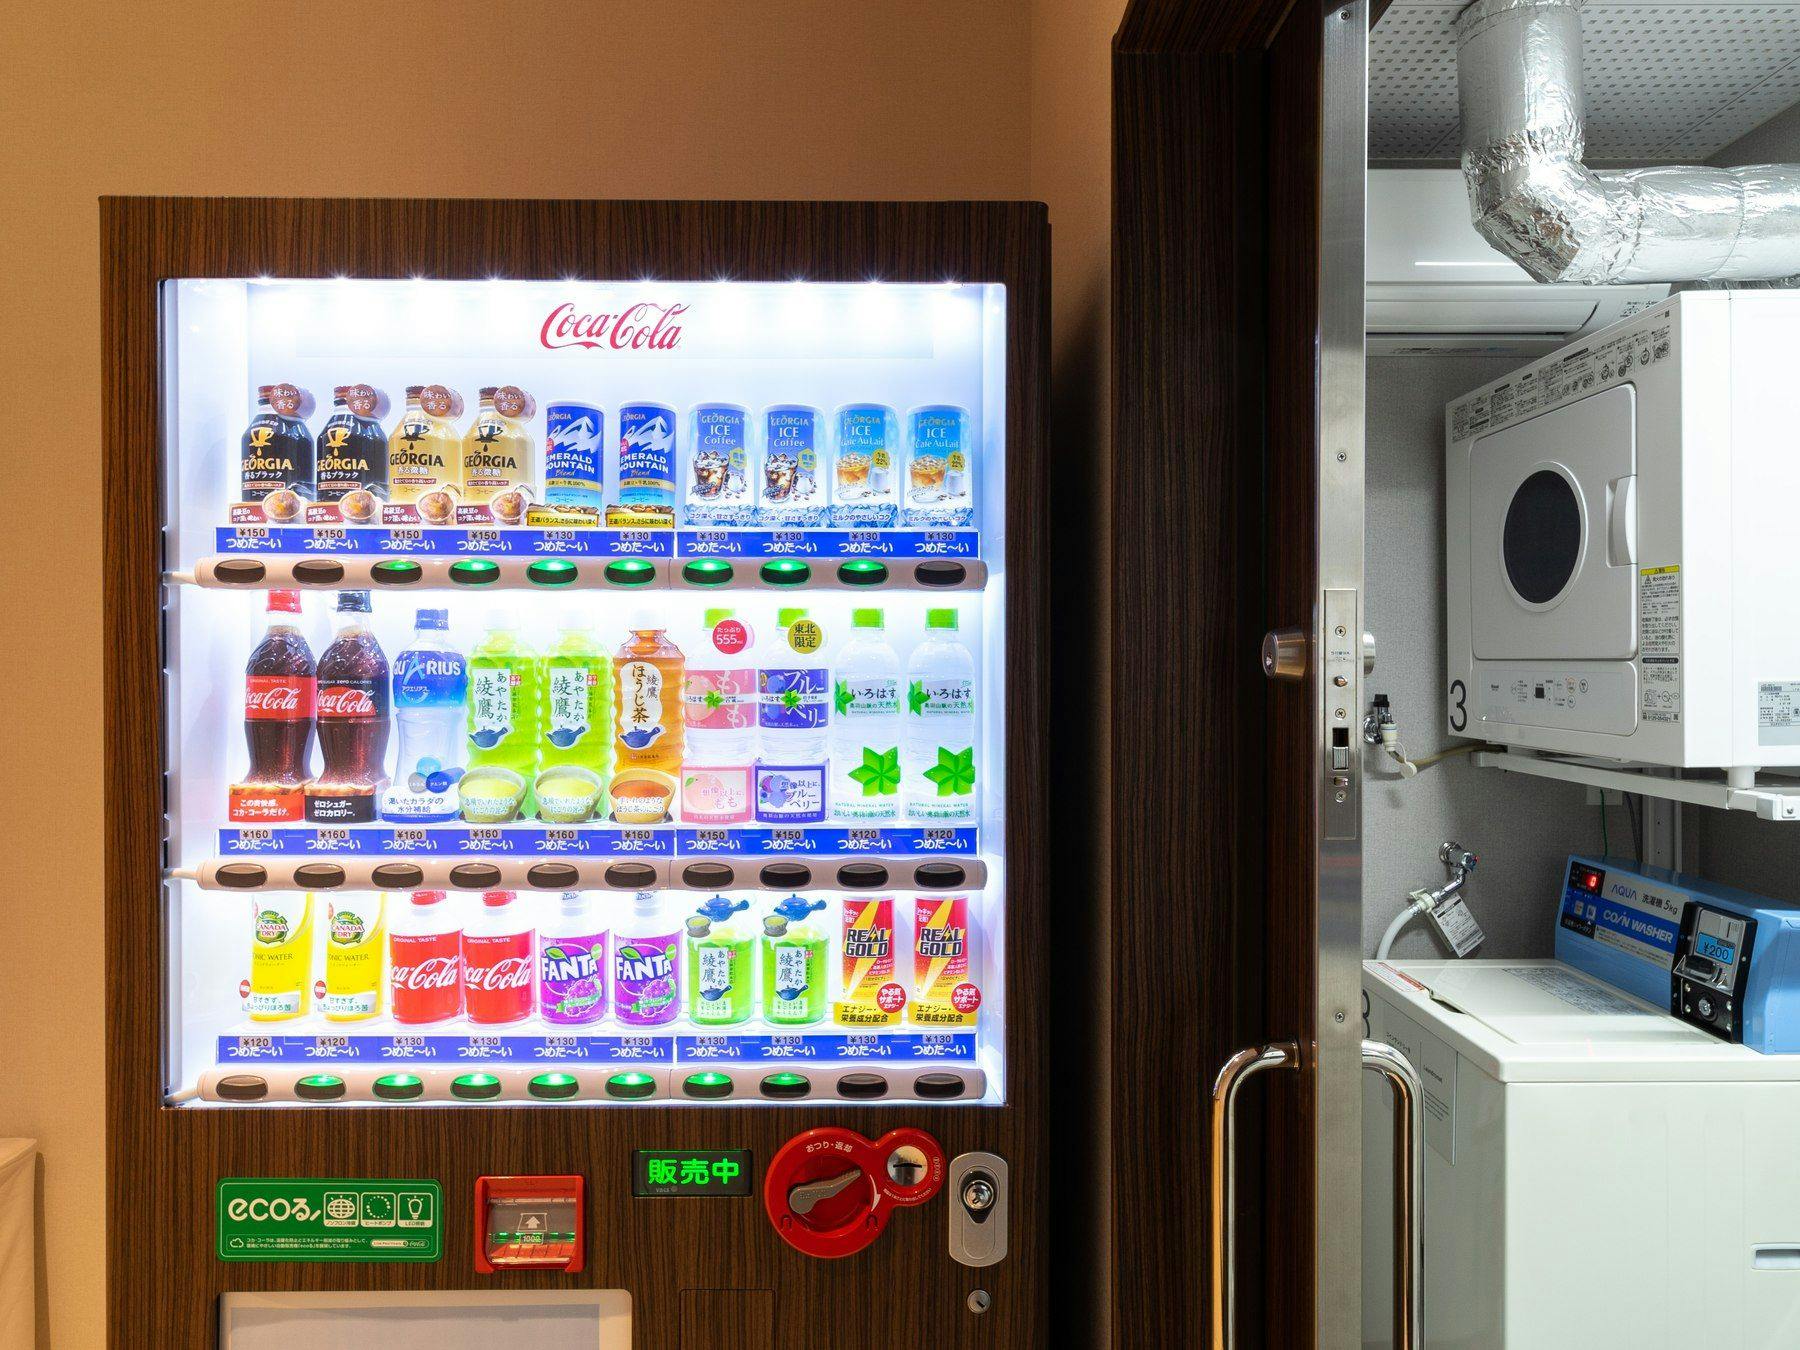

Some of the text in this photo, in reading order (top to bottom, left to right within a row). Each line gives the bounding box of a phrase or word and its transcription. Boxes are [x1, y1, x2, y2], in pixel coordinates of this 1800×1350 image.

[540, 302, 692, 350] Coca-Cola
[273, 388, 297, 397] 味わい
[349, 388, 374, 397] 味わい
[424, 391, 451, 400] 味わい
[497, 392, 522, 400] 味わい
[276, 400, 294, 410] 香る
[353, 400, 370, 410] 香る
[427, 401, 446, 410] 香る
[501, 401, 517, 410] 香る
[701, 412, 741, 424] GEORGIA
[771, 415, 809, 427] GEORGIA
[710, 424, 731, 436] ICE
[779, 427, 800, 438] ICE
[852, 426, 872, 436] ICE
[926, 428, 947, 439] ICE
[704, 435, 736, 446] Coffee
[774, 437, 805, 447] Coffee
[390, 450, 444, 466] GEORGIA
[465, 451, 517, 468] GEORGIA
[244, 471, 283, 479] 香るブラック
[321, 471, 359, 479] 香るブラック
[240, 529, 265, 537] ¥150
[317, 530, 343, 538] ¥150
[394, 531, 419, 539] ¥150
[472, 531, 497, 539] ¥150
[546, 531, 573, 539] ¥130
[623, 532, 649, 540] ¥130
[776, 533, 802, 541] ¥130
[852, 533, 877, 541] ¥130
[928, 533, 954, 541] ¥130
[794, 623, 816, 634] 東北
[794, 636, 816, 648] 限定
[646, 674, 659, 699] 綾鷹
[475, 676, 495, 720] 綾鷹
[497, 672, 508, 723] あやたか
[552, 675, 572, 719] 綾鷹
[573, 670, 585, 722] あやたか
[632, 664, 650, 724] ほうじ茶
[1450, 679, 1467, 732] 3
[314, 801, 352, 809] ゼロシュガー
[790, 800, 820, 810] ベリー
[314, 809, 355, 817] ゼロカロリー。
[243, 830, 269, 839] ¥160
[320, 830, 346, 839] ¥160
[397, 831, 423, 840] ¥160
[473, 830, 498, 839] ¥160
[548, 830, 575, 839] ¥160
[624, 830, 650, 839] ¥160
[700, 831, 725, 840] ¥150
[776, 831, 801, 840] ¥150
[852, 831, 877, 839] ¥120
[927, 831, 953, 839] ¥120
[1611, 884, 1678, 915] AQUA 洗濯機 5kg
[332, 924, 363, 932] CANADA
[1603, 909, 1630, 927] COIN
[1631, 919, 1674, 944] WASHER
[846, 924, 888, 942] REAL
[920, 924, 963, 942] REAL
[846, 942, 889, 957] GOLD
[920, 942, 963, 957] GOLD
[1704, 941, 1729, 960] ¥200
[268, 953, 294, 961] WATER
[344, 953, 369, 961] WATER
[541, 952, 598, 981] FANTA
[616, 952, 673, 981] FANTA
[702, 953, 716, 983] 綾鷹
[717, 949, 726, 985] あやたか
[780, 953, 794, 983] 綾鷹
[794, 949, 803, 985] あやたか
[879, 996, 904, 1004] サポート
[954, 996, 979, 1004] サポート
[841, 1014, 889, 1023] 栄養成分配合
[915, 1014, 963, 1023] 栄養成分配合
[243, 1038, 269, 1047] ¥120
[320, 1038, 345, 1046] ¥120
[395, 1037, 422, 1045] ¥130
[472, 1037, 499, 1045] ¥130
[548, 1037, 575, 1045] ¥130
[624, 1037, 650, 1045] ¥130
[699, 1037, 725, 1045] ¥130
[774, 1037, 801, 1045] ¥130
[850, 1036, 876, 1044] ¥130
[925, 1036, 951, 1044] ¥130
[648, 1158, 739, 1185] 販売中
